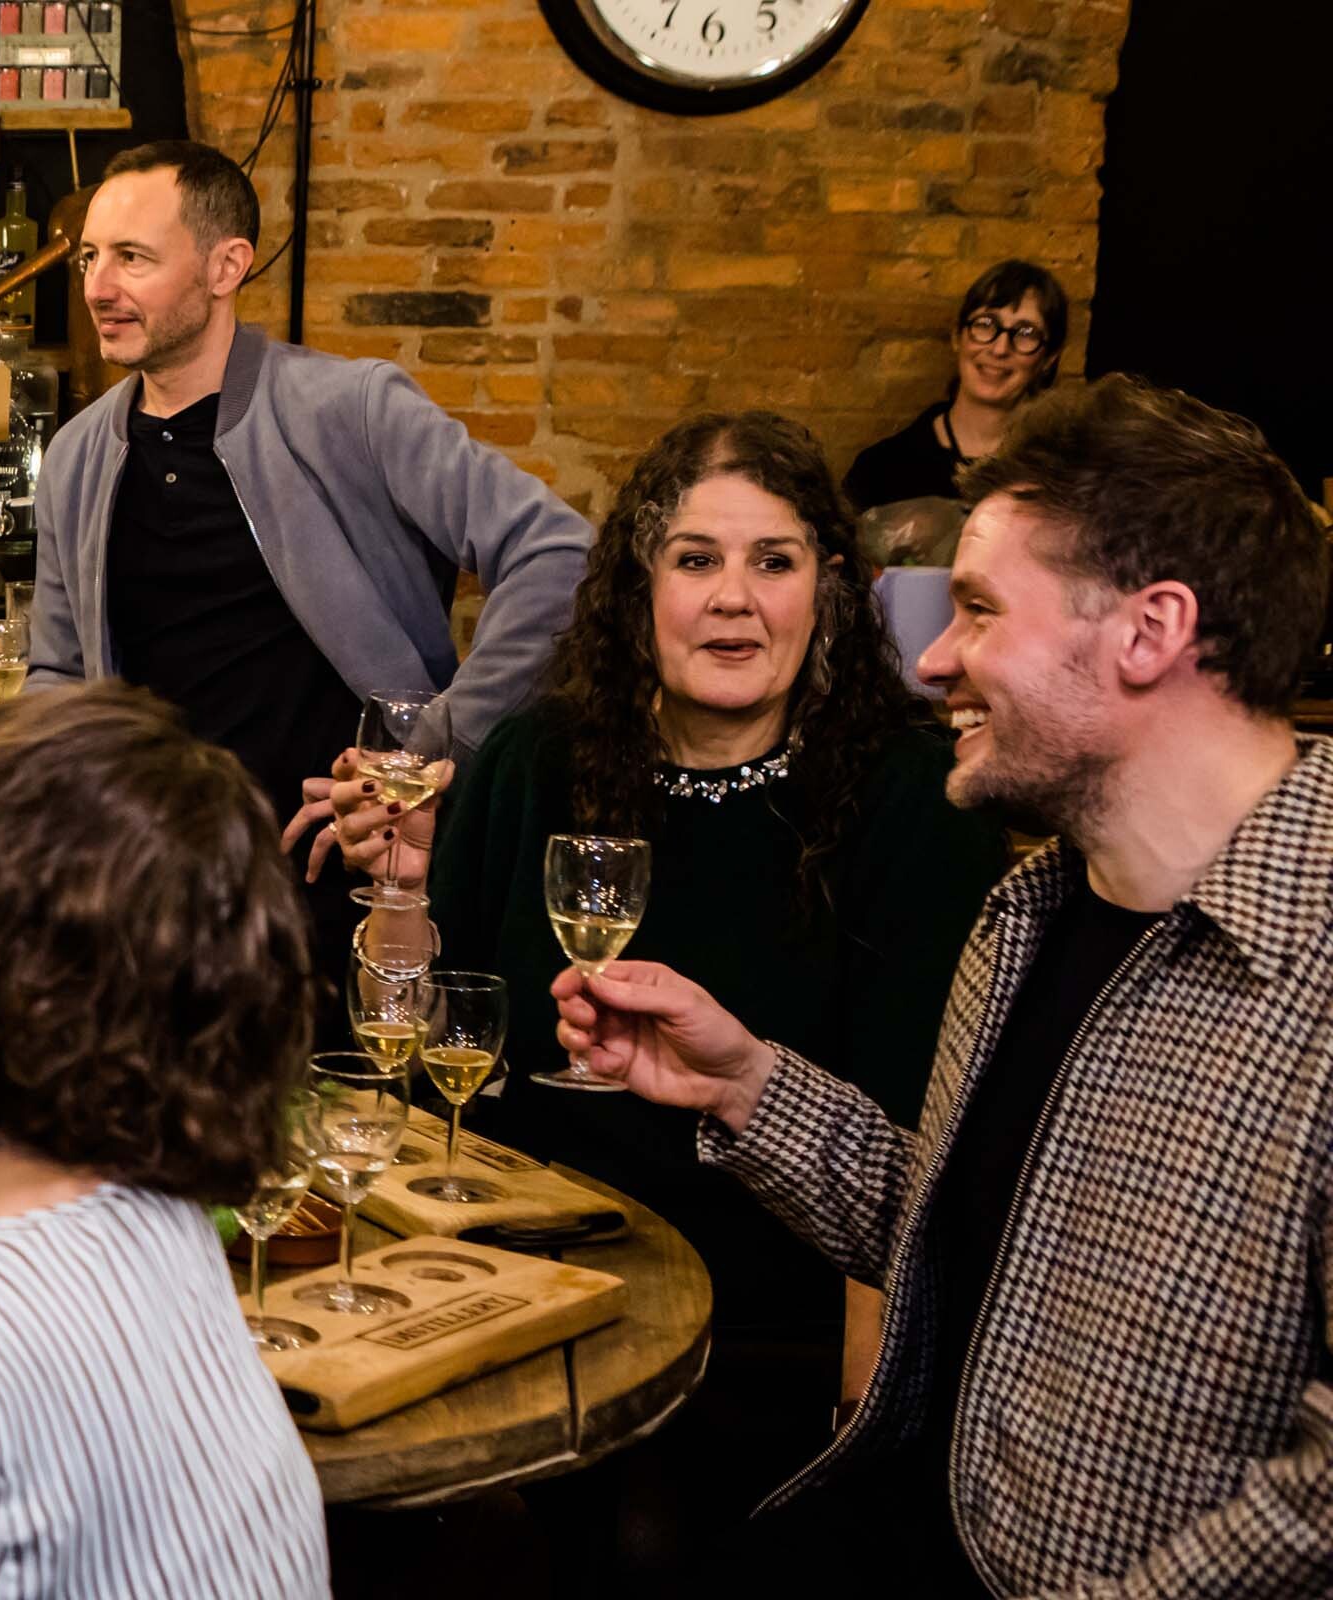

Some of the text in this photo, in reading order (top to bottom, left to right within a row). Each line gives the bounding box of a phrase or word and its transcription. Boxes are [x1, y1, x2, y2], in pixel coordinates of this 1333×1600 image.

[660, 0, 681, 29] 7
[701, 8, 726, 46] 6
[756, 0, 778, 33] 5
[381, 1297, 507, 1344] DISTILLERY
